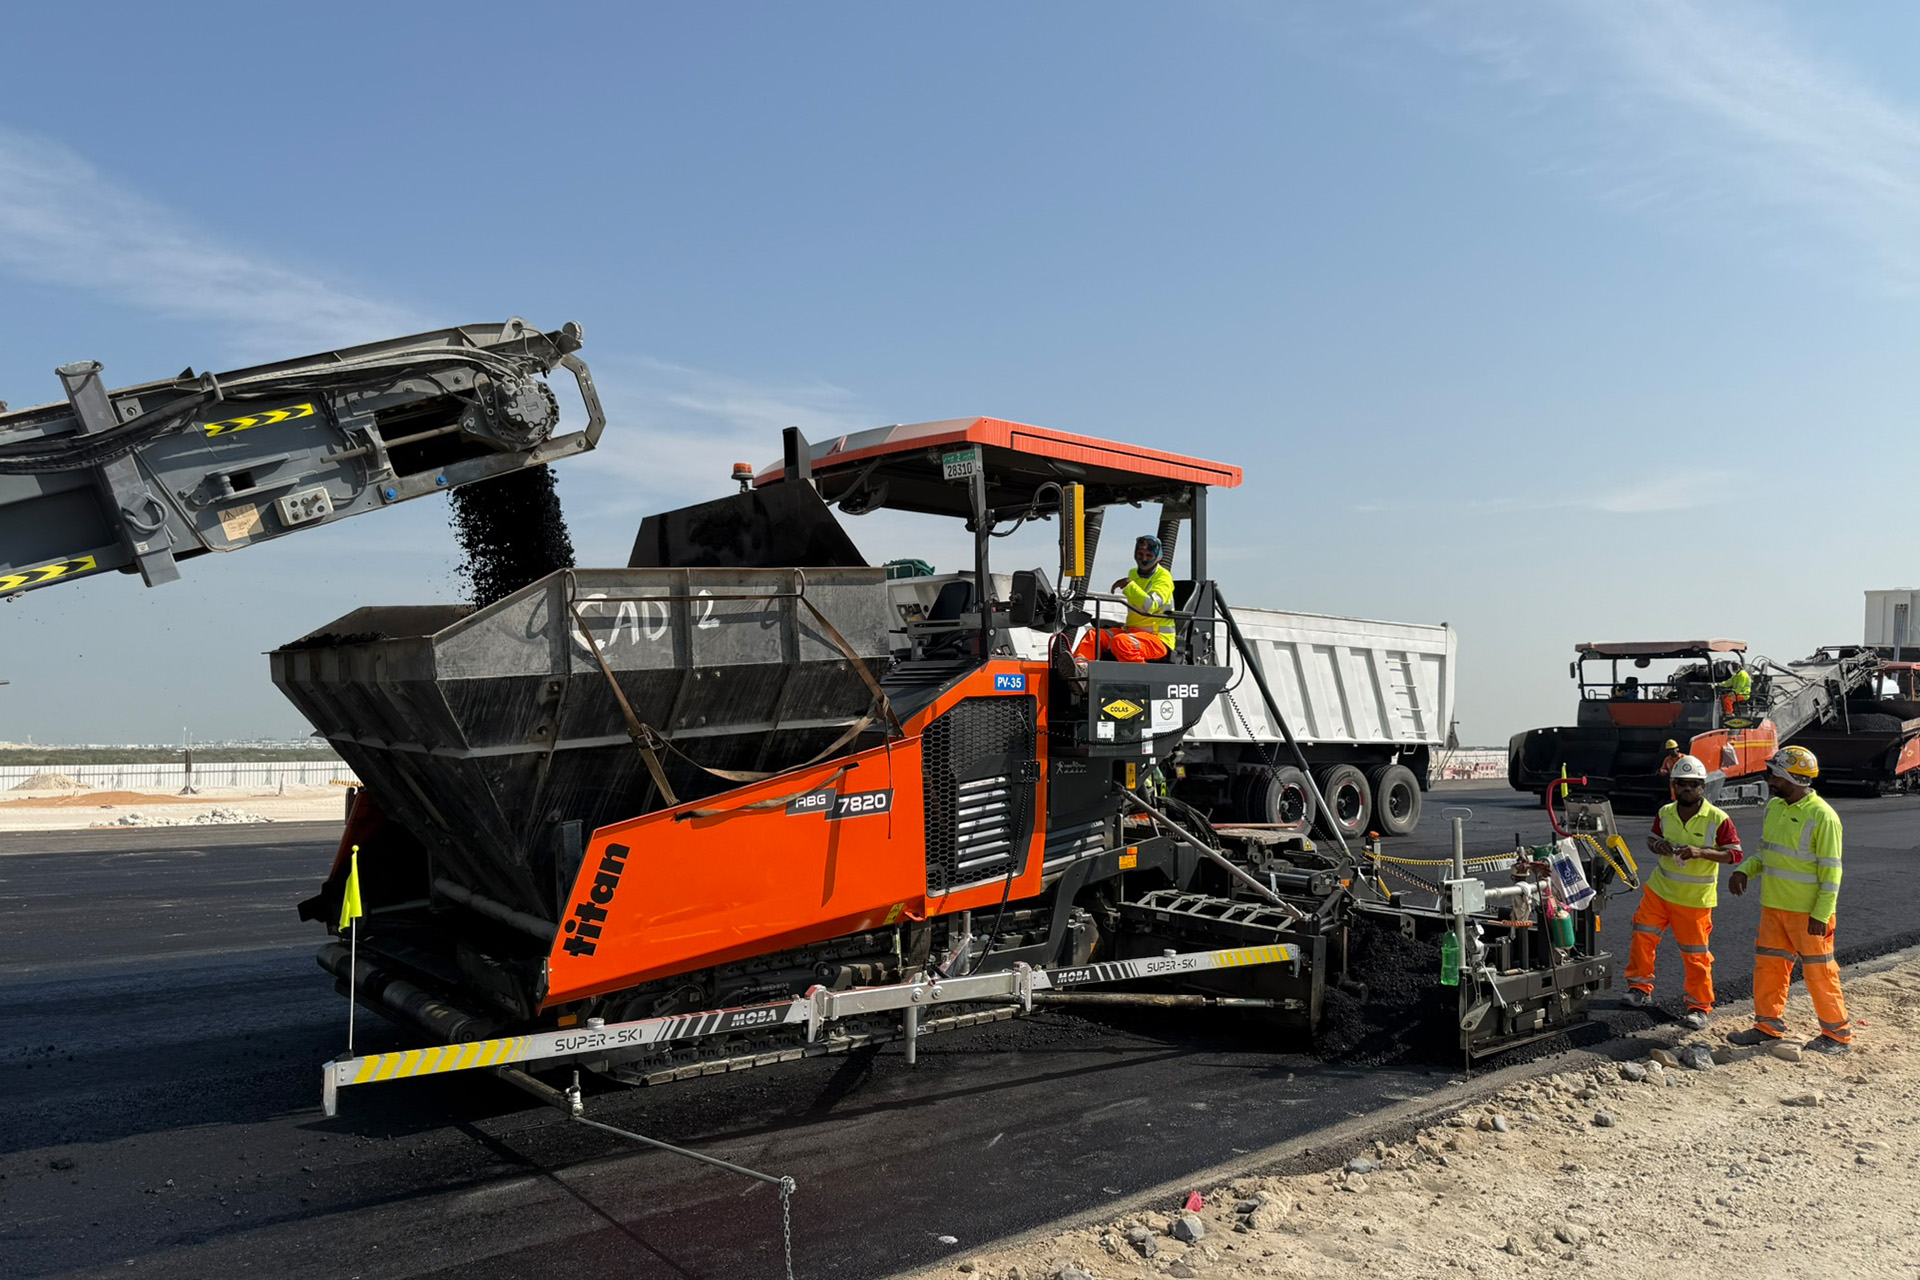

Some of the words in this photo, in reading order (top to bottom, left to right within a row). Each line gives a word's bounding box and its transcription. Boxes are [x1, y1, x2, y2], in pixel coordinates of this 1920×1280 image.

[947, 462, 973, 477] 28310
[572, 593, 668, 652] CAD
[696, 589, 721, 630] 2
[997, 676, 1022, 688] PV-35
[1167, 684, 1199, 698] ABG
[795, 794, 826, 808] ABG
[838, 793, 886, 813] 7820
[562, 843, 631, 957] titan
[1057, 969, 1091, 984] MOBA
[731, 1009, 778, 1027] MOBA
